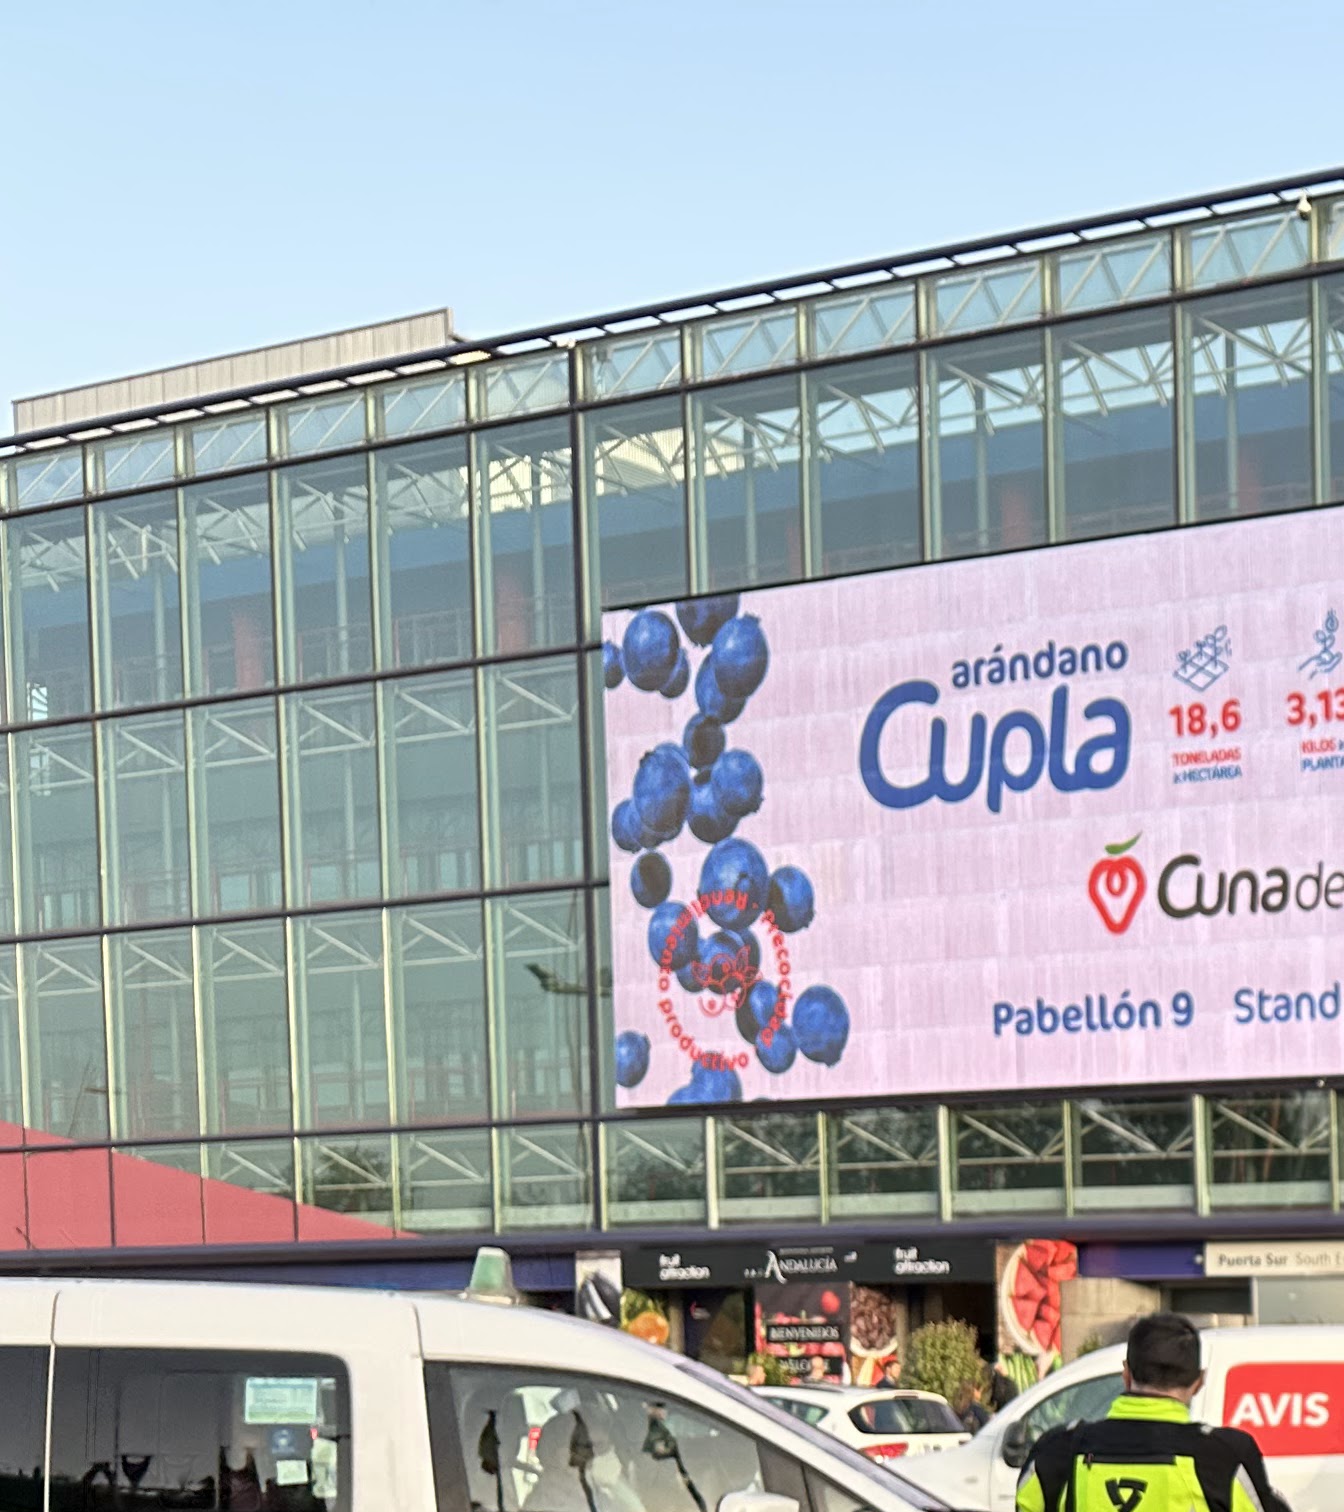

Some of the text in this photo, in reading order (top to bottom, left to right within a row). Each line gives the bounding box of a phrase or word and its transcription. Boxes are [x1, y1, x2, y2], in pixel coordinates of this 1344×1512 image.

[952, 640, 1129, 690] arándano
[1168, 698, 1243, 739] 18,6
[859, 680, 1132, 814] Cupla
[1302, 737, 1337, 754] KILOS
[1157, 853, 1291, 919] Cuna
[993, 988, 1195, 1037] Pabellón 9
[1233, 981, 1341, 1025] Stand
[1217, 1253, 1262, 1267] Puerta
[1265, 1253, 1288, 1267] Sur
[1295, 1252, 1331, 1266] South
[1230, 1391, 1331, 1429] AVIS
